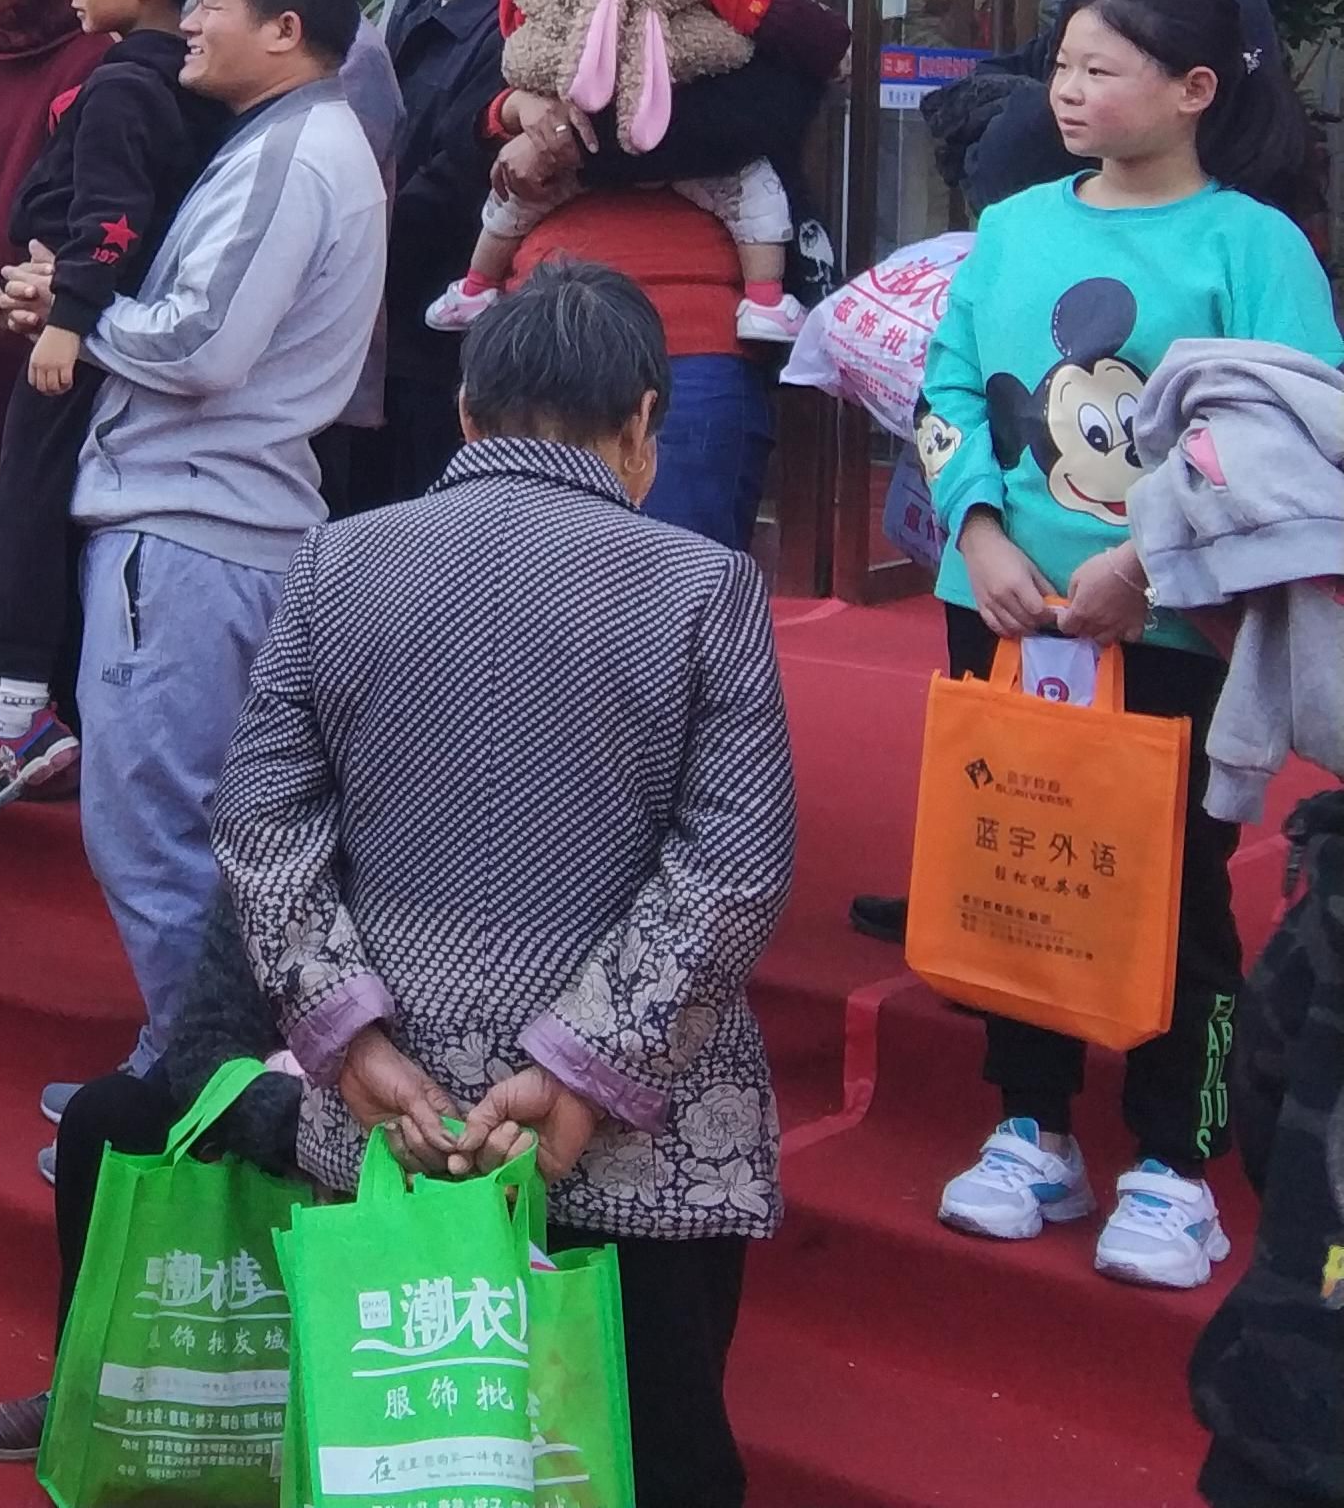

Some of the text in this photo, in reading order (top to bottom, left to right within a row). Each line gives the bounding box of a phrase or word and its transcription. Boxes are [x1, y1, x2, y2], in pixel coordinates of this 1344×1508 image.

[975, 816, 1118, 878] 蓝宇外语
[399, 1275, 529, 1350] 潮衣
